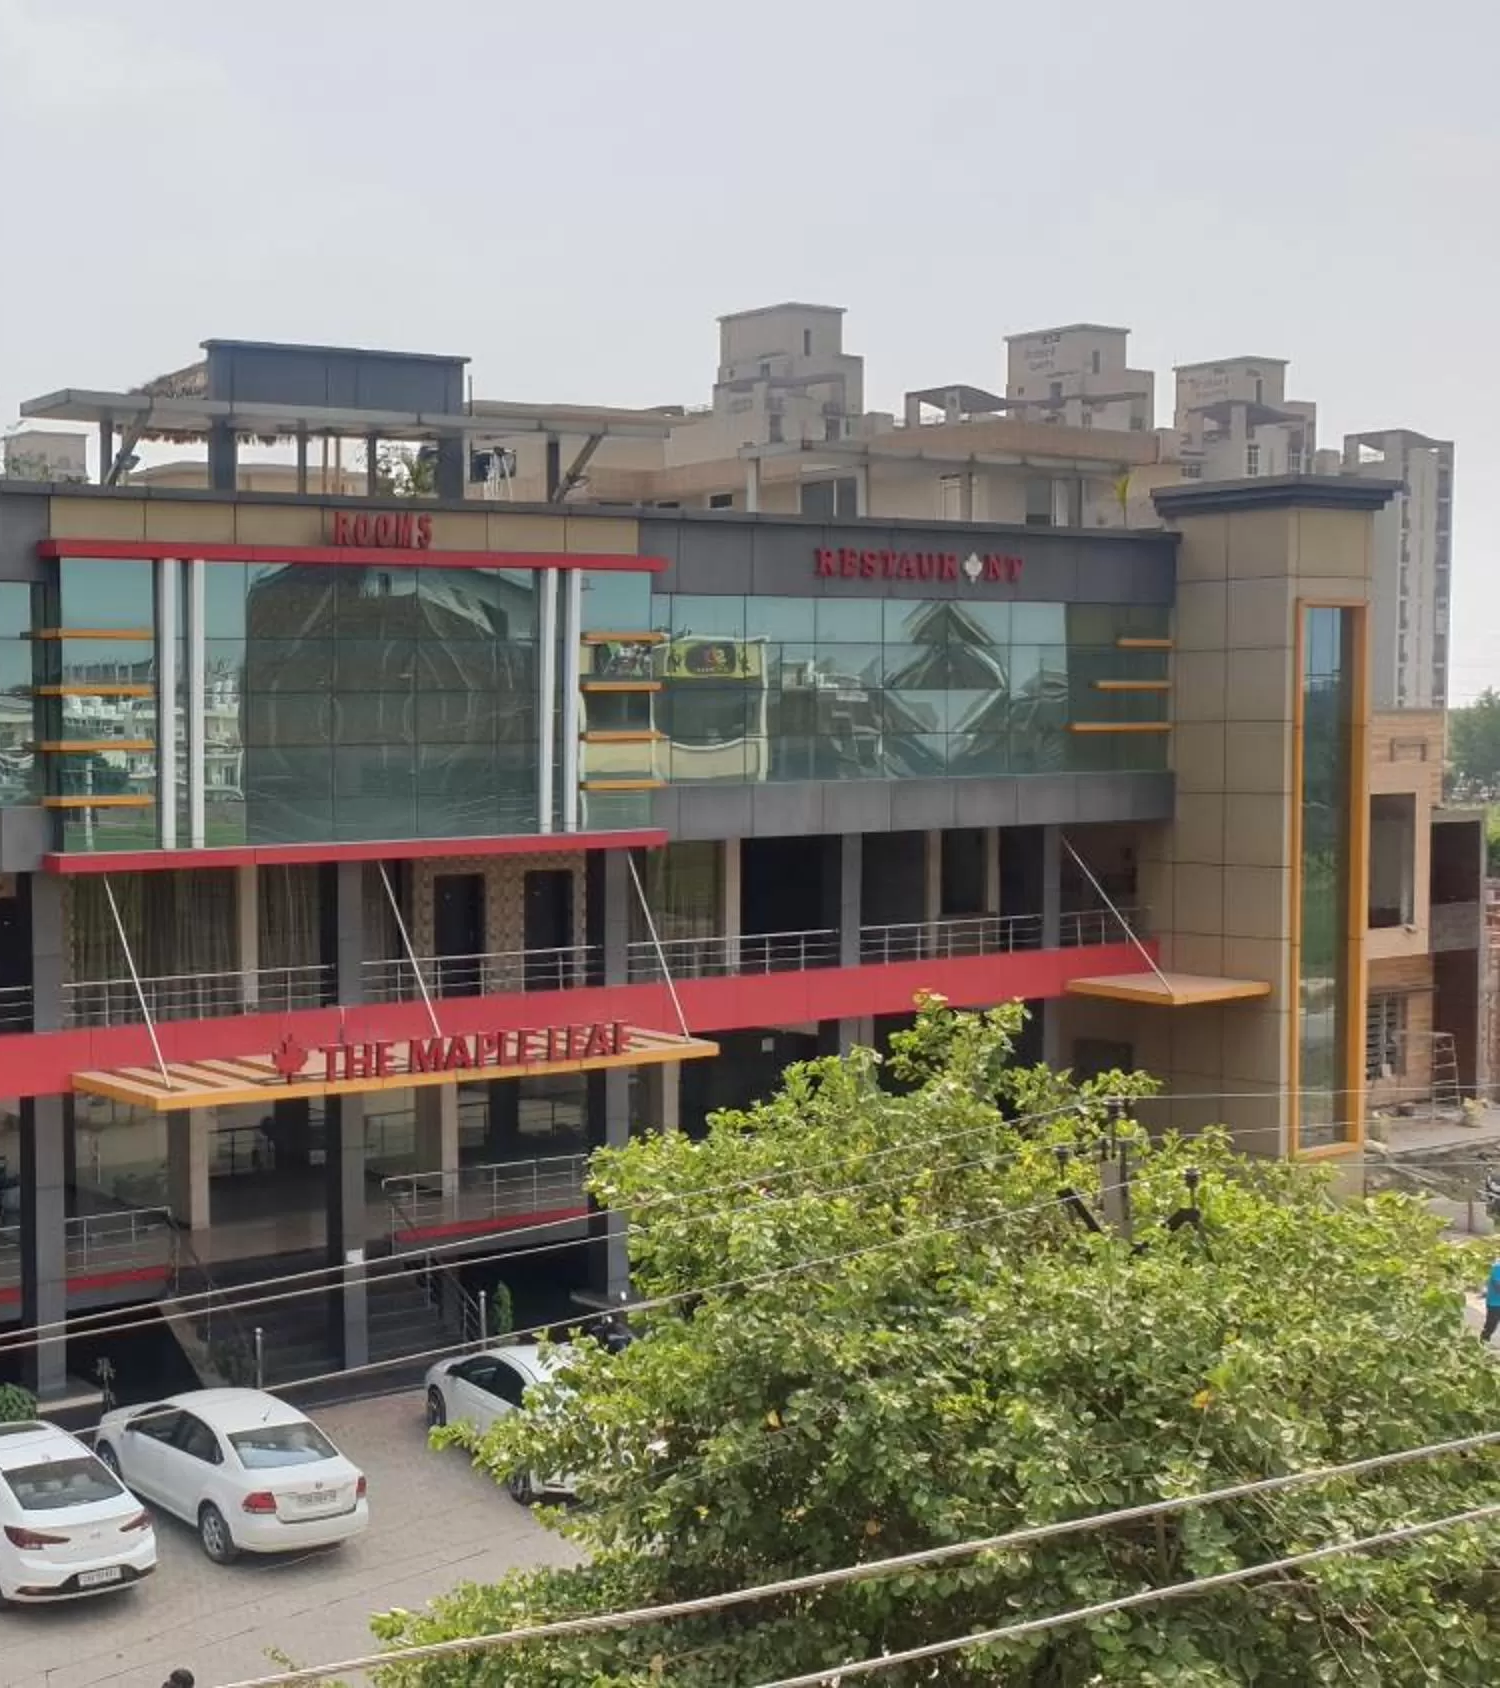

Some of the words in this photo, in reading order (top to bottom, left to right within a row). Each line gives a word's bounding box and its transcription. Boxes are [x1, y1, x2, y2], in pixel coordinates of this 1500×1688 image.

[333, 511, 433, 549] ROOMS
[813, 547, 1024, 583] RESTAURNT
[319, 1040, 396, 1083] THE
[408, 1027, 537, 1073] MAPLE
[547, 1021, 633, 1061] LEAF
